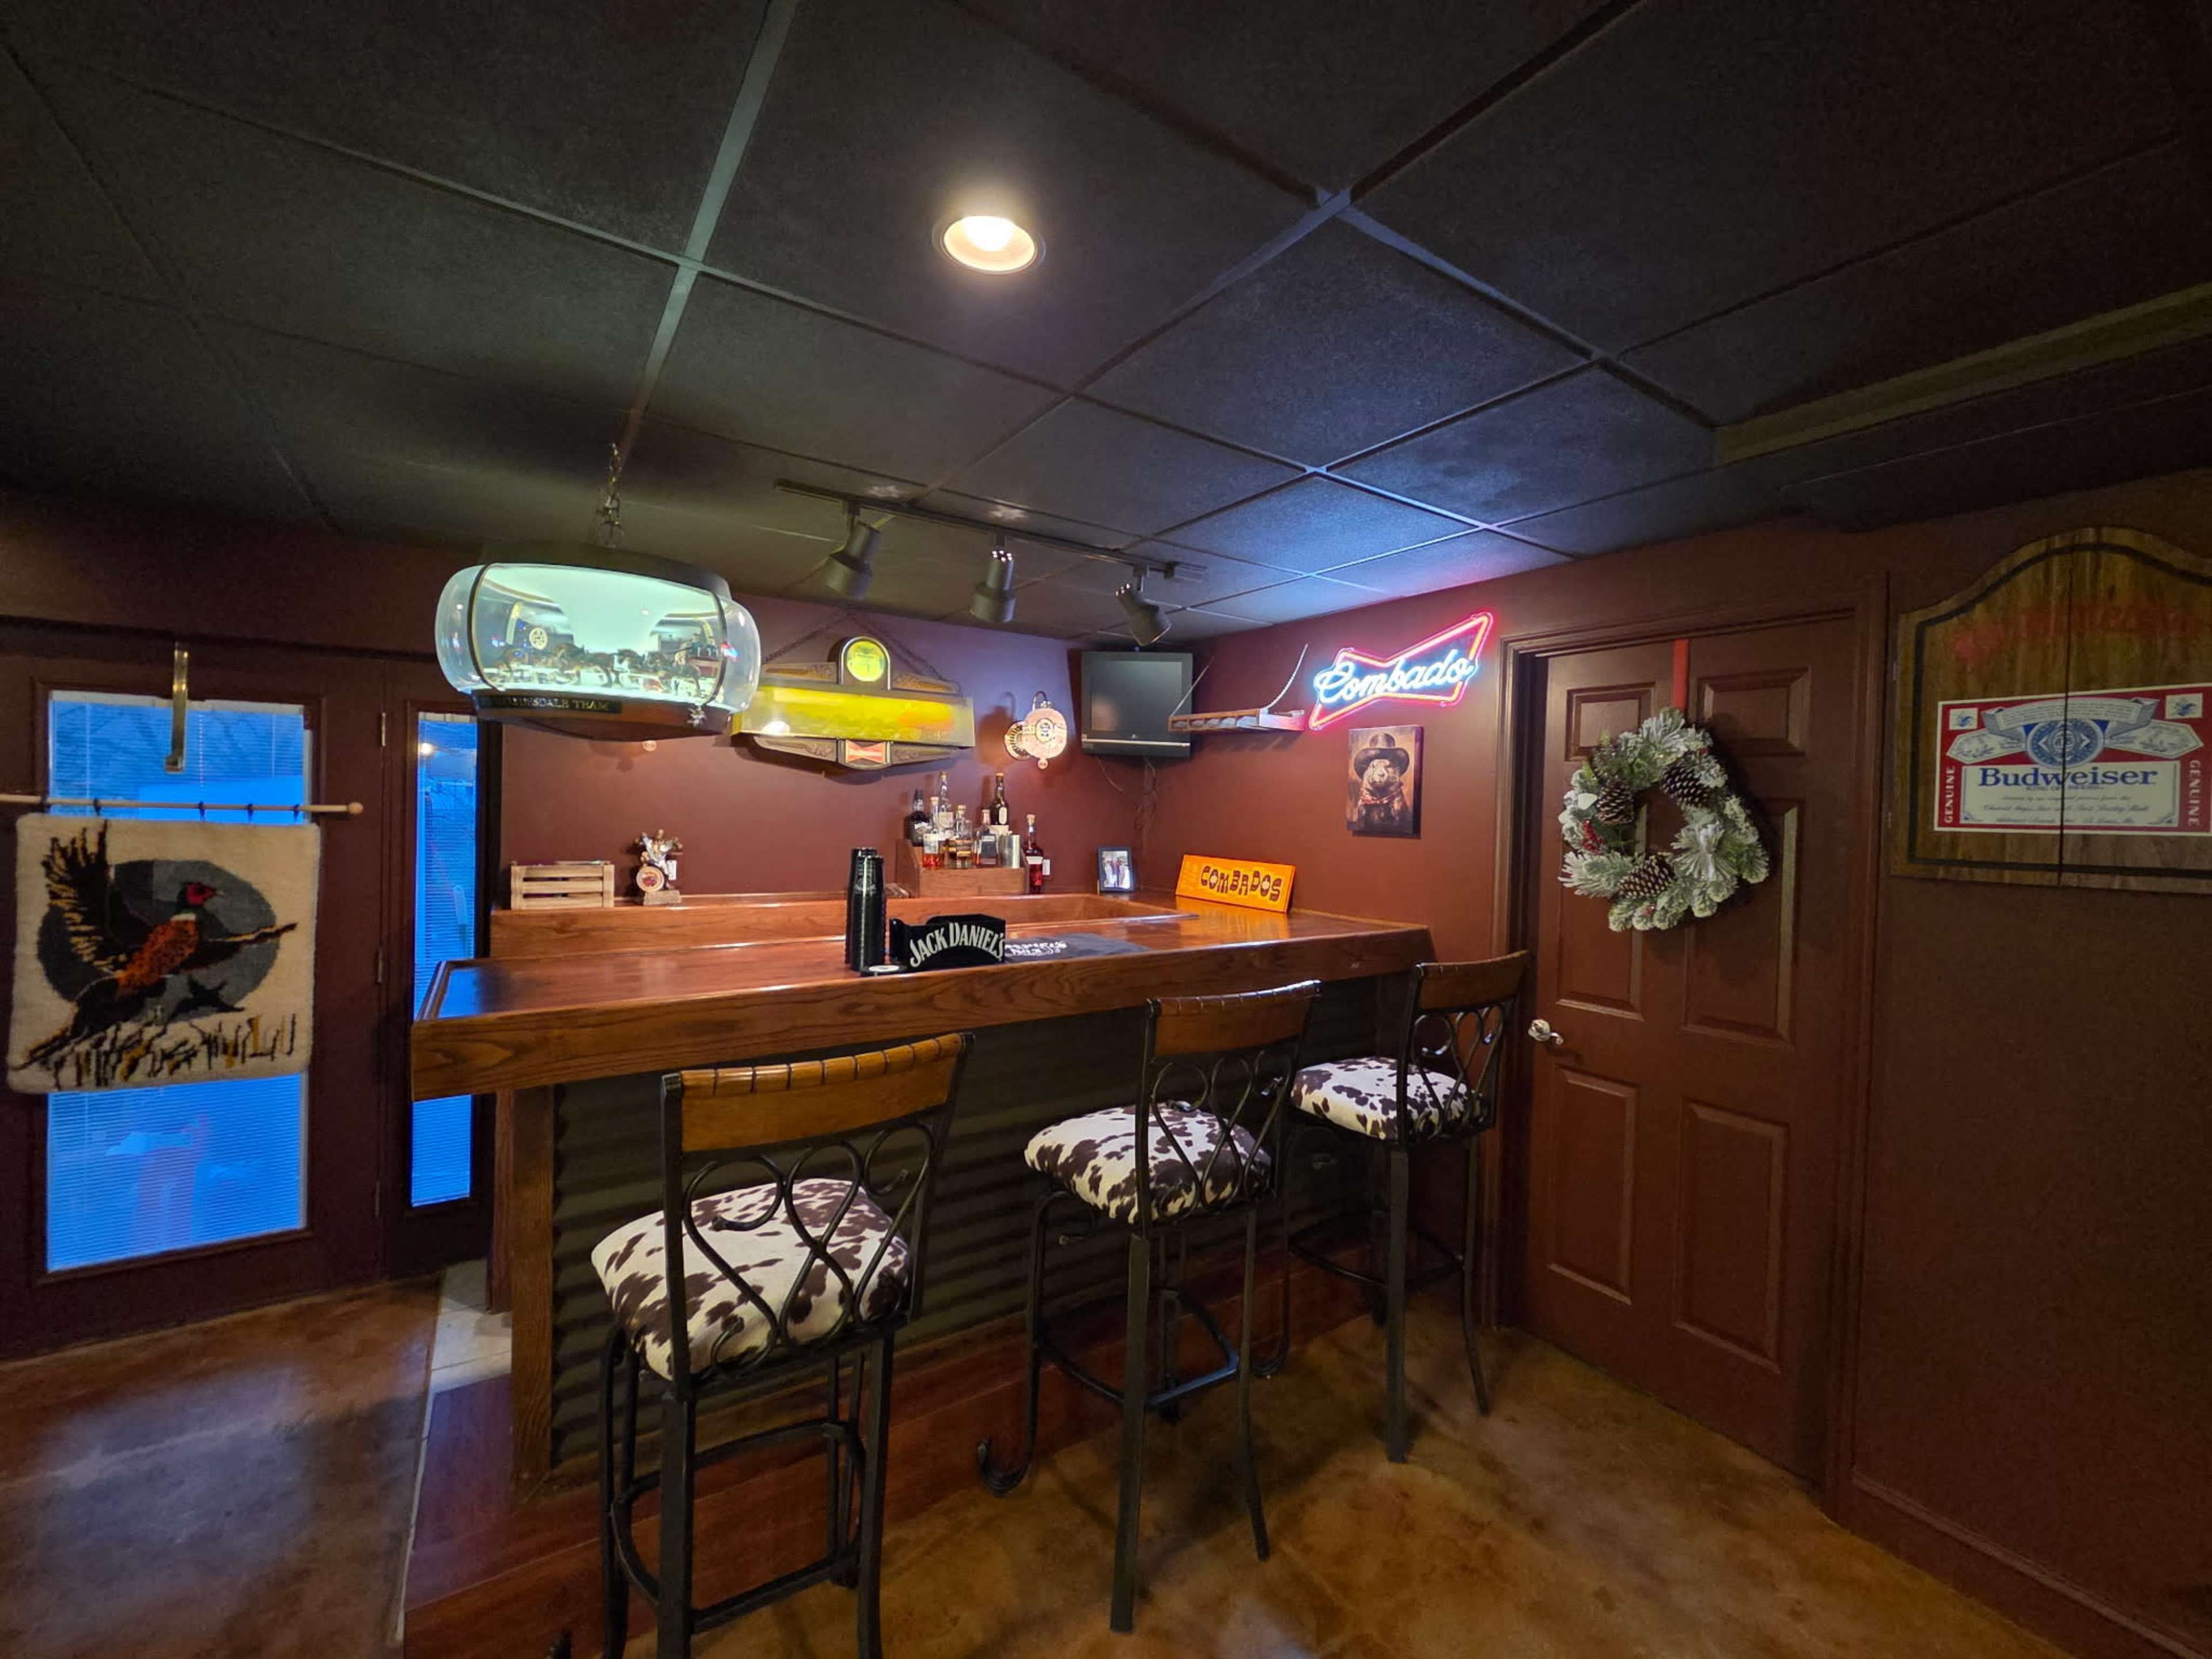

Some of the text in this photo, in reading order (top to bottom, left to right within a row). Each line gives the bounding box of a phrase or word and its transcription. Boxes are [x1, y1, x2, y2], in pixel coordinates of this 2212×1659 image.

[1944, 766, 1956, 823] GENUINE
[1978, 766, 2159, 786] Budweiser
[2188, 760, 2199, 827] GENUINE
[1200, 865, 1282, 902] COMBADOS
[909, 922, 1006, 968] JACK DANIEL'S
